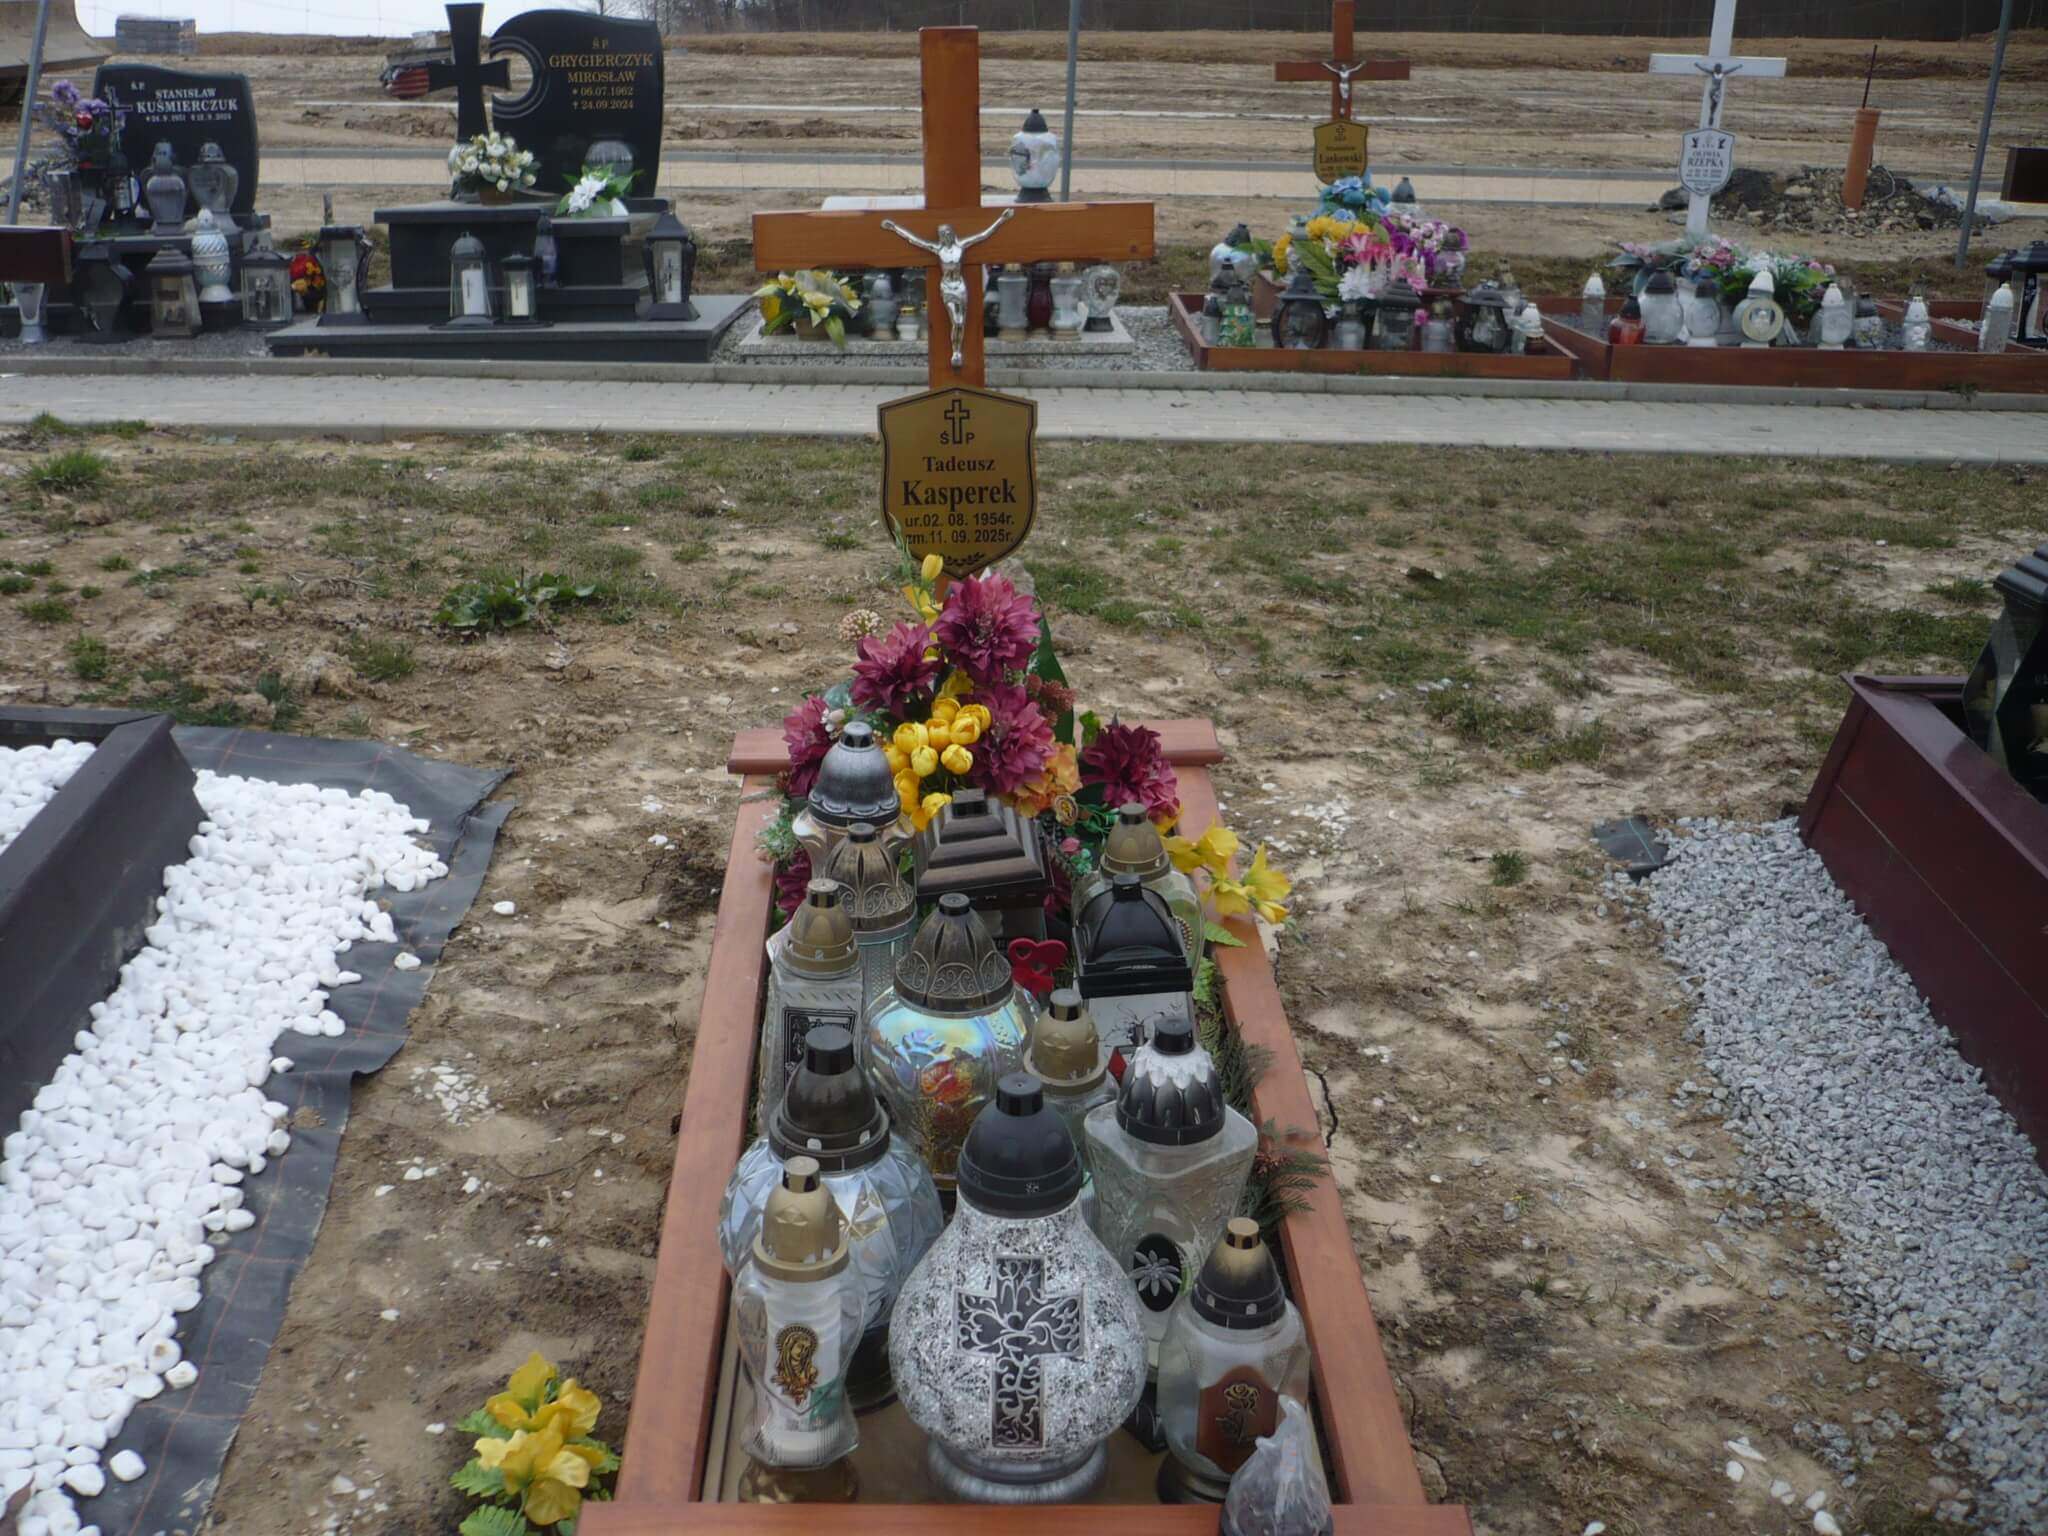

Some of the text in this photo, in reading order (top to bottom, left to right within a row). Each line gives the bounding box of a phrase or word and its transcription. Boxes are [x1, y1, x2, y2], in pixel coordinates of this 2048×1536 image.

[549, 53, 654, 68] GRYGIERCZYK
[567, 71, 636, 83] MIROSŁAW
[136, 98, 238, 113] KUŚMIERCZUK
[1687, 157, 1724, 168] RZEPKA
[922, 455, 996, 472] Tadeusz
[902, 478, 1017, 512] Kasperek
